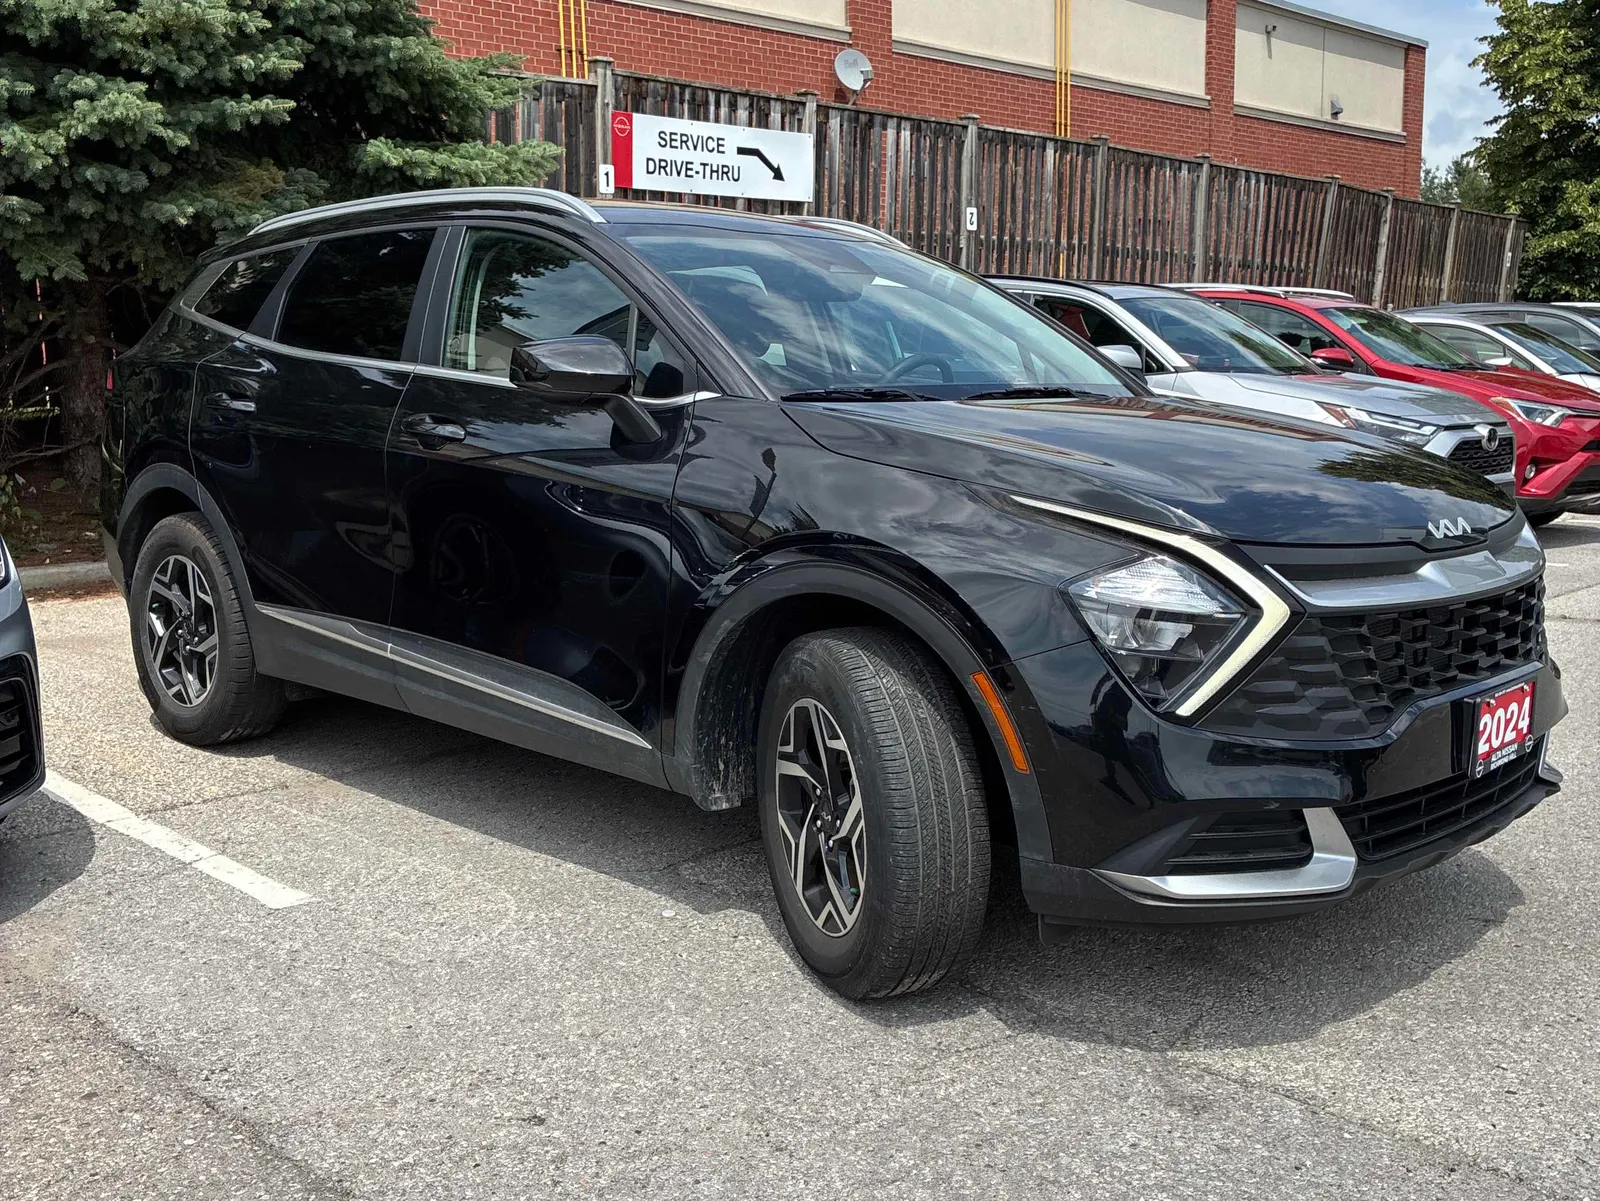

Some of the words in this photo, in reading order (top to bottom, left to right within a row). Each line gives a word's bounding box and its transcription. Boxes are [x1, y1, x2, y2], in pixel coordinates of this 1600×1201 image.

[657, 130, 726, 154] SERVICE
[603, 170, 610, 188] 1
[645, 157, 741, 182] DRIVE-THRU
[1427, 516, 1472, 539] KIA
[1477, 696, 1531, 755] 2024
[1502, 743, 1517, 756] NISSAN
